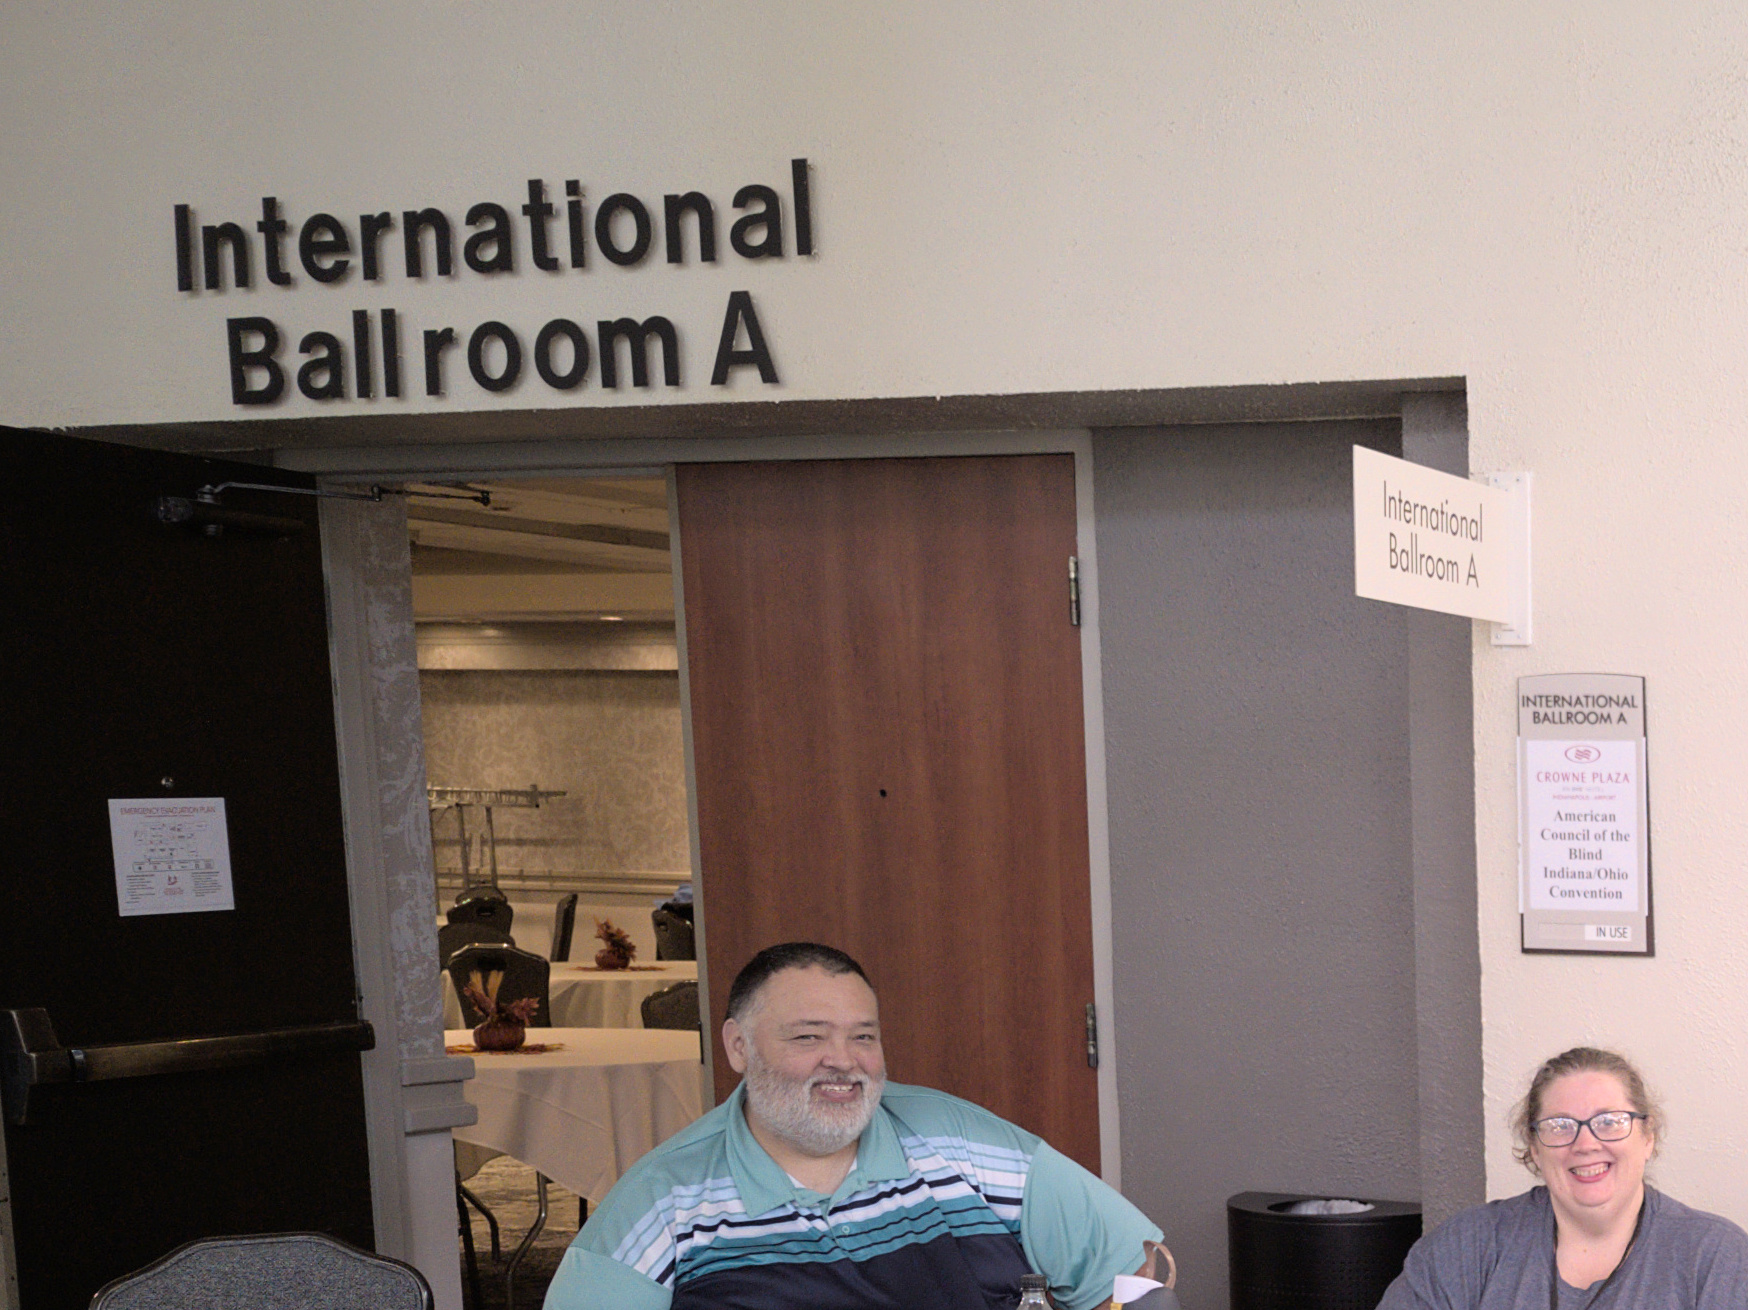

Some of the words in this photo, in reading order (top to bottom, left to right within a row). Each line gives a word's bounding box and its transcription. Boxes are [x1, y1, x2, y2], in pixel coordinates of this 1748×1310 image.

[174, 158, 817, 292] International
[226, 307, 683, 406] Ballroom
[710, 290, 781, 386] A
[1383, 480, 1483, 543] International
[1389, 532, 1460, 584] Ballroom
[1466, 553, 1480, 589] A
[1521, 695, 1639, 709] INTERNATIONAL
[1533, 711, 1612, 725] BALLROOM
[1617, 712, 1628, 725] A
[1537, 771, 1586, 784] CROWNE
[1592, 772, 1630, 784] PLAZA
[1553, 810, 1617, 823] American
[1540, 828, 1591, 842] Council
[1594, 829, 1607, 842] of
[1610, 830, 1631, 842] the
[1568, 848, 1603, 861] Blind
[1543, 867, 1629, 881] Indiana/Ohio
[1549, 886, 1623, 900] Convention
[1596, 927, 1606, 938] IN
[1609, 927, 1629, 939] USE
